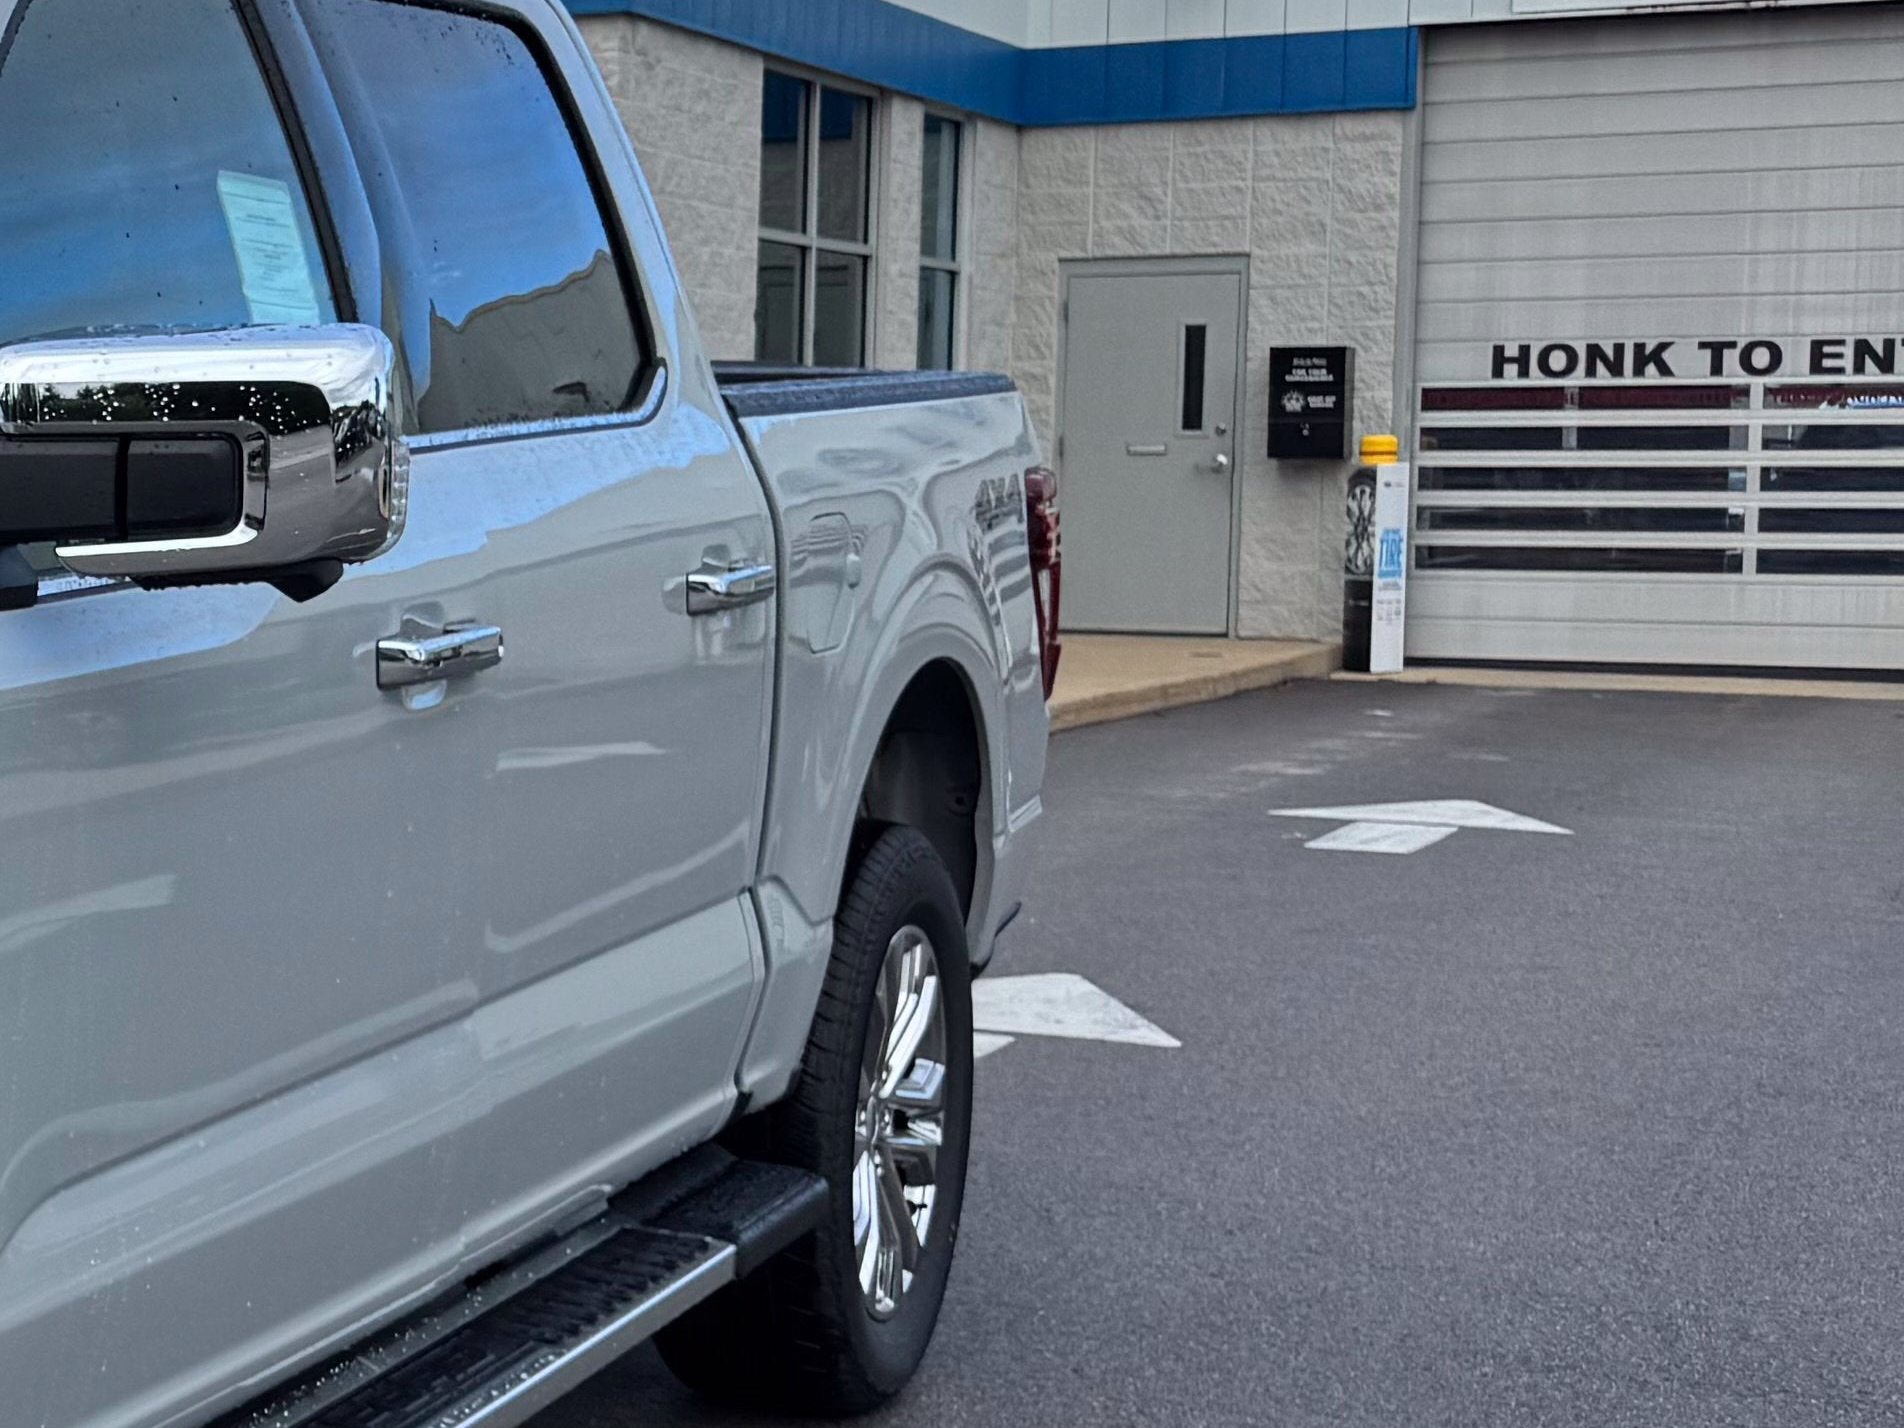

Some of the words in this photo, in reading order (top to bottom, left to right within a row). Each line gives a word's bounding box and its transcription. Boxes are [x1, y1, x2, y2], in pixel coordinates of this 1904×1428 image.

[1492, 341, 1676, 379] HONK
[1697, 340, 1784, 376] TO
[1809, 338, 1904, 375] EN
